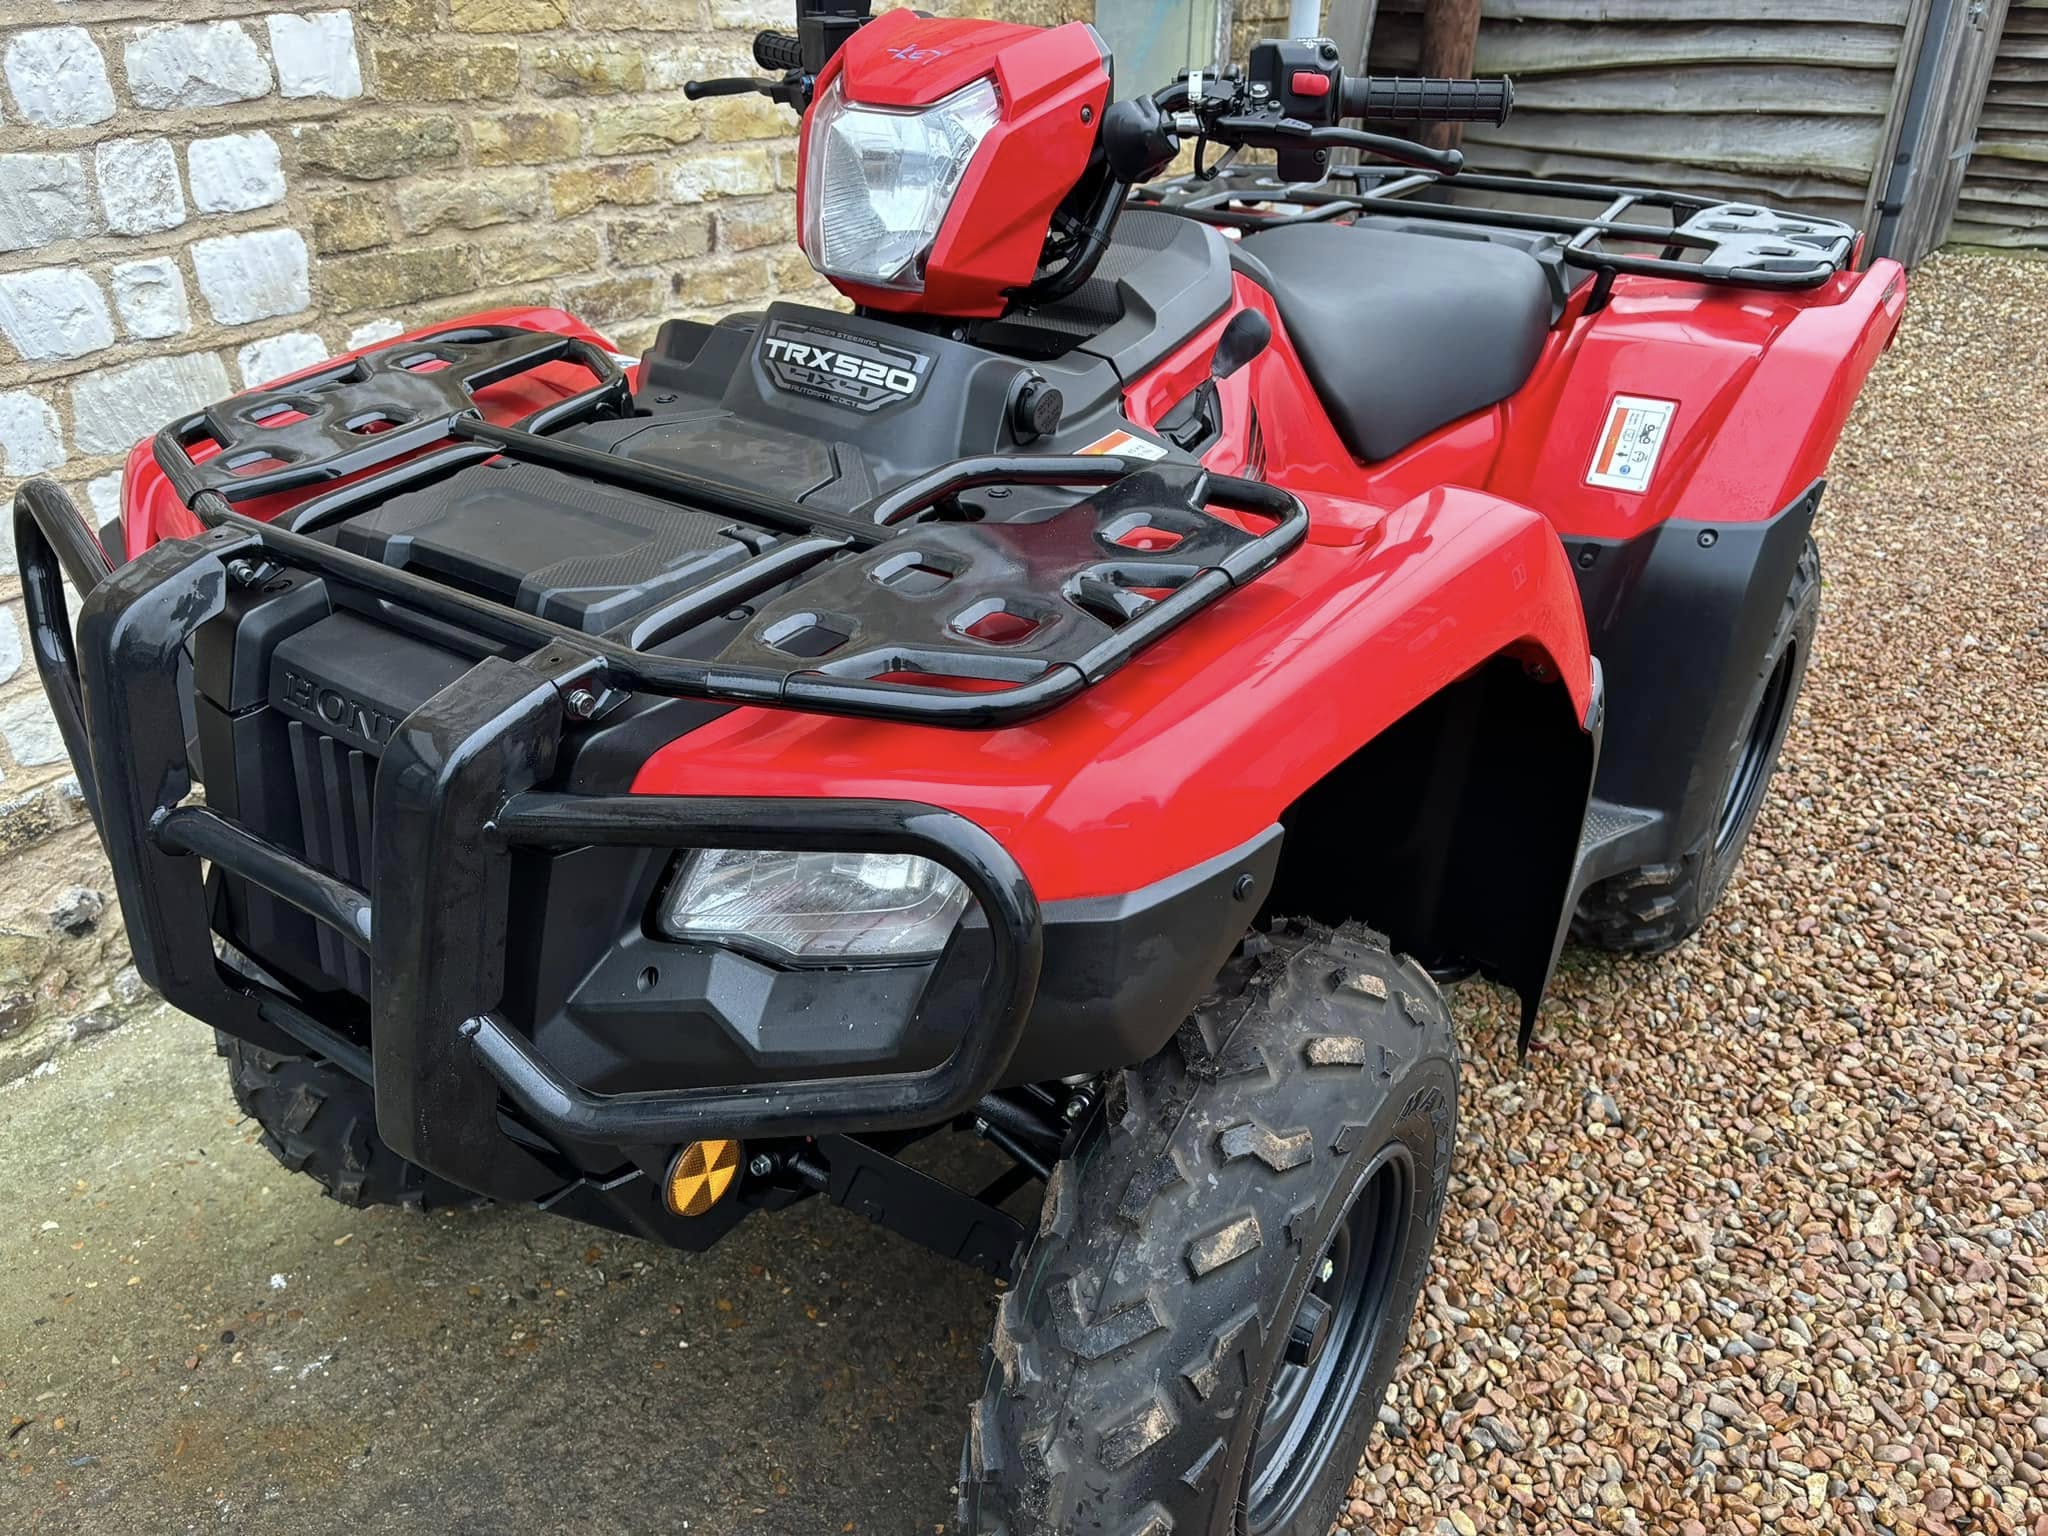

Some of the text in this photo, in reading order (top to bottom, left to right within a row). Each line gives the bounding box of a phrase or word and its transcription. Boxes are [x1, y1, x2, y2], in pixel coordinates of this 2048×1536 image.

[809, 326, 879, 347] POWER STEERING
[765, 338, 918, 394] TRX520
[791, 384, 859, 408] AUTOMATIC DCT
